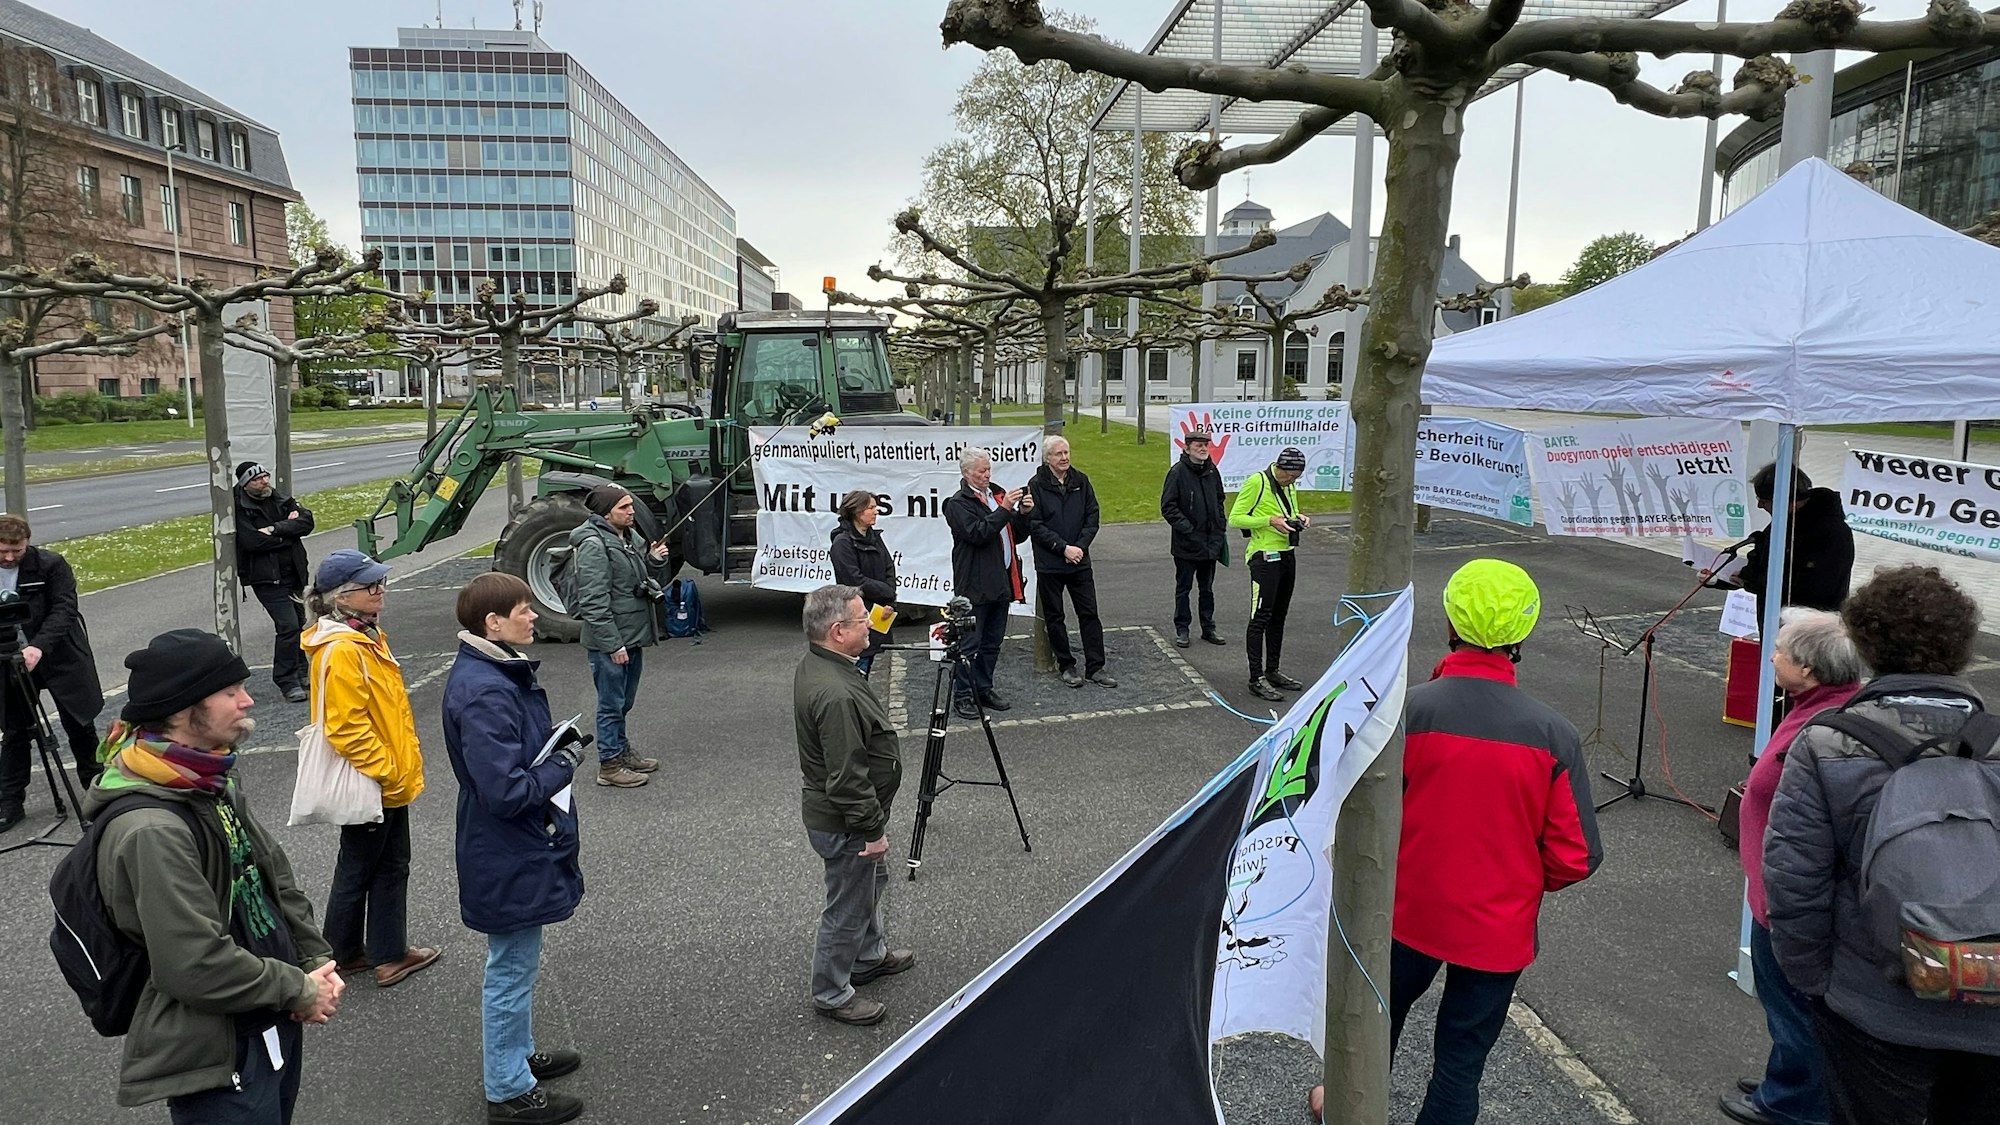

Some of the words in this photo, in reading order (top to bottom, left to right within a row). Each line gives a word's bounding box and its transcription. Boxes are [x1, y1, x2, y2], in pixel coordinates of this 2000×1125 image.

[1213, 407, 1251, 419] Keine
[1256, 405, 1313, 420] Öffnung
[1318, 406, 1341, 418] der
[493, 419, 531, 427] FENDT
[1196, 420, 1339, 434] BAYER-Giftmüllhalde
[1238, 434, 1321, 447] Leverkusen!
[1417, 429, 1484, 447] cherheit
[1487, 436, 1504, 452] für
[1543, 435, 1580, 448] BAYER:
[664, 450, 697, 458] ENDT
[754, 441, 860, 463] genmanipuliert,
[864, 441, 940, 465] patentiert,
[1547, 444, 1633, 463] Duogynon-Opfer
[1637, 440, 1733, 457] entschädigen!
[1317, 465, 1340, 476] CBG
[1430, 448, 1523, 478] Bevölkerung!
[1677, 456, 1733, 475] Jetzt!
[1852, 450, 1970, 485] Weder
[763, 483, 816, 513] Mit
[830, 492, 893, 517] us
[1433, 486, 1500, 504] BAYER-Gefahren
[1511, 494, 1530, 508] CBG
[1850, 488, 1936, 518] noch
[1610, 515, 1636, 526] gegen
[1638, 514, 1712, 524] BAYER-Gefahren
[1936, 530, 1985, 545] gegen
[760, 562, 832, 581] bäuerliche
